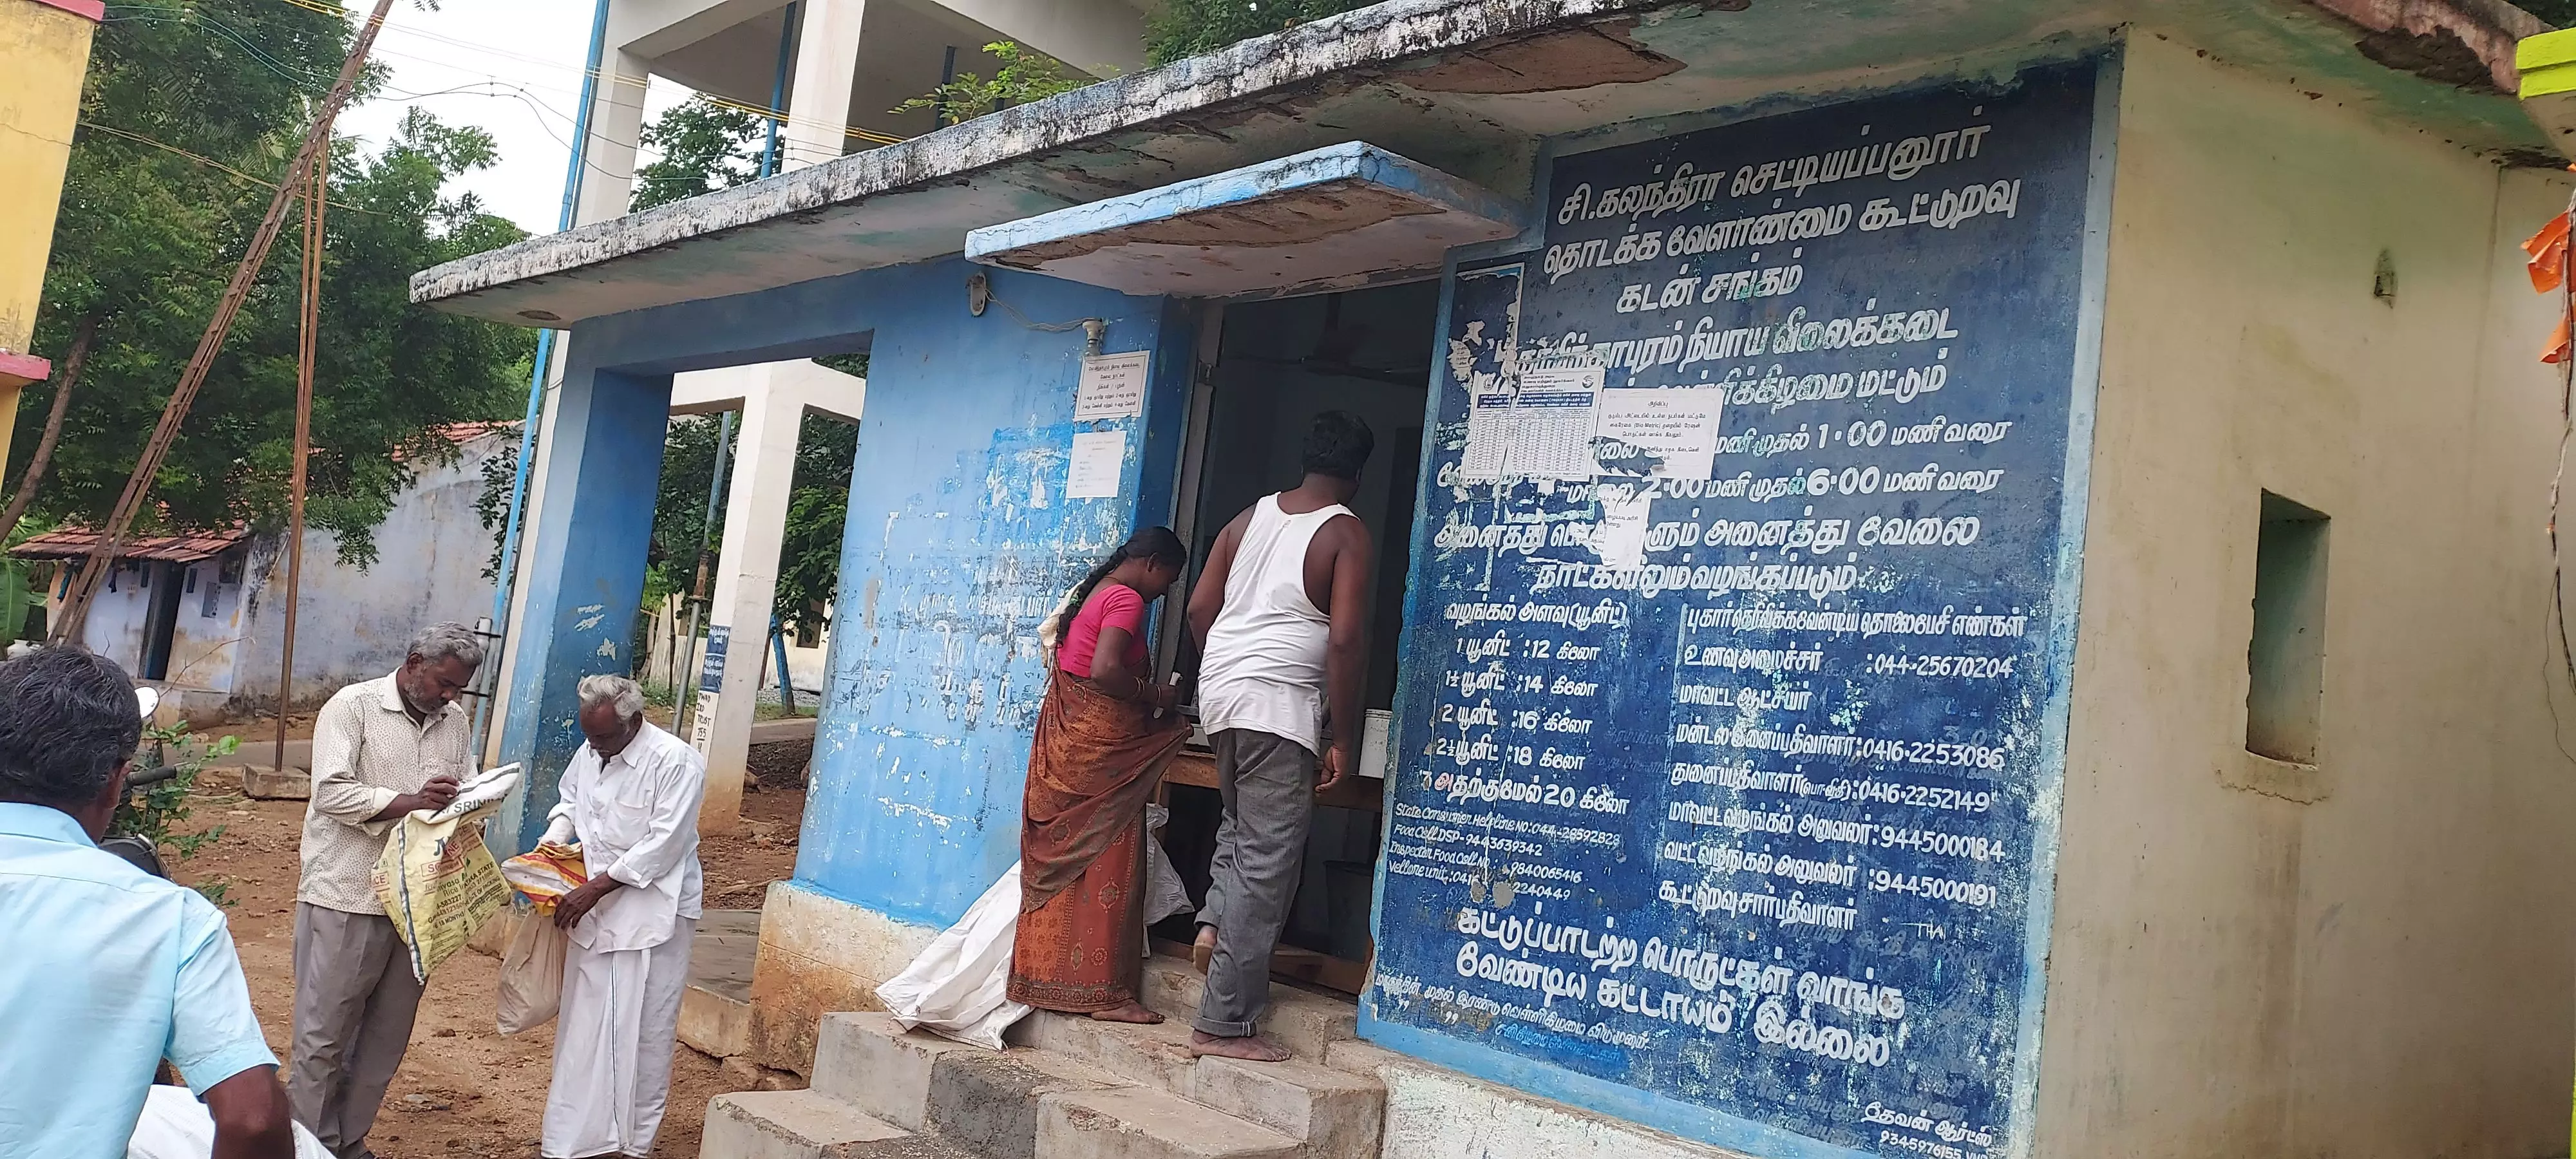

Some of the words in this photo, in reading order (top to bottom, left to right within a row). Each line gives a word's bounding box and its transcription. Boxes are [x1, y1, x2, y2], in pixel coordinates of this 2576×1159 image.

[1730, 106, 1991, 198] செட்டியப்பனூர்
[1544, 218, 1662, 285] தொடக்க
[1667, 198, 1852, 258] வேளாண்மை
[1858, 178, 2022, 234] கூட்டுறவு
[1616, 263, 1700, 314] கடன்
[1701, 247, 1804, 305] சங்கம்
[1679, 316, 1768, 373] நியாய
[1772, 297, 1958, 353] விலைக்கடை
[1855, 348, 1947, 404] மட்டும்
[1754, 423, 1809, 458] முதல்
[1890, 415, 1946, 446] மணி
[1944, 420, 2012, 443] வரை
[1705, 467, 1750, 499] மணி
[1748, 467, 1806, 504] முதல்
[1882, 462, 1940, 493] மணி
[1937, 467, 2004, 493] வரை
[1703, 505, 1851, 556] அனைத்து
[1857, 515, 1981, 547] வேலை
[1444, 594, 1516, 630] வழங்கல்
[1687, 601, 1734, 634] புகார்
[1861, 605, 1955, 639] தொலைபேசி
[1952, 605, 2028, 637] எண்கள்
[1456, 637, 1462, 654] 1
[1466, 629, 1511, 663] யூனிட்
[1556, 641, 1601, 661] கிலோ
[1683, 645, 1738, 674] உணவு
[1736, 641, 1824, 672] அமைச்சர்
[1460, 663, 1505, 697] யூனிட்
[1550, 674, 1599, 697] கிலோ
[1678, 683, 1735, 708] மாவட்ட
[1737, 679, 1813, 712] ஆட்சியர்
[1442, 704, 1454, 722] 2
[1457, 698, 1499, 731] யூனிட்
[1543, 711, 1593, 735] கிலோ
[1454, 733, 1499, 765] யூனிட்
[1539, 747, 1586, 771] கிலோ
[1395, 804, 1421, 818] State
[1421, 807, 1473, 827] Consumer
[1472, 811, 1515, 831] Helpline
[1544, 784, 1576, 807] 20
[1579, 784, 1631, 815] கிலோ
[1394, 824, 1415, 838] Food
[1414, 825, 1439, 842] Cell
[477, 861, 495, 876] STATE
[1388, 840, 1434, 860] Inspector
[1433, 848, 1457, 864] Food
[1456, 851, 1477, 867] Cell
[1510, 861, 1582, 883] 9840065416
[1388, 859, 1425, 877] Vellore
[1512, 882, 1571, 900] 2240449
[1774, 854, 1858, 887] அலுவலர்
[1457, 901, 1638, 973] கட்டுப்பாடற்ற
[1642, 936, 1794, 994] பொருட்கள்
[1797, 967, 1906, 1020] வாங்க
[1456, 990, 1501, 1016] இரண்டு
[1456, 940, 1587, 1008] வேண்டிய
[1598, 977, 1736, 1033] கட்டாயம்
[1754, 1001, 1891, 1068] இல்லை
[1860, 1100, 1935, 1133] தேவன்
[1935, 1120, 1994, 1147] ஆர்ட்ஸ்
